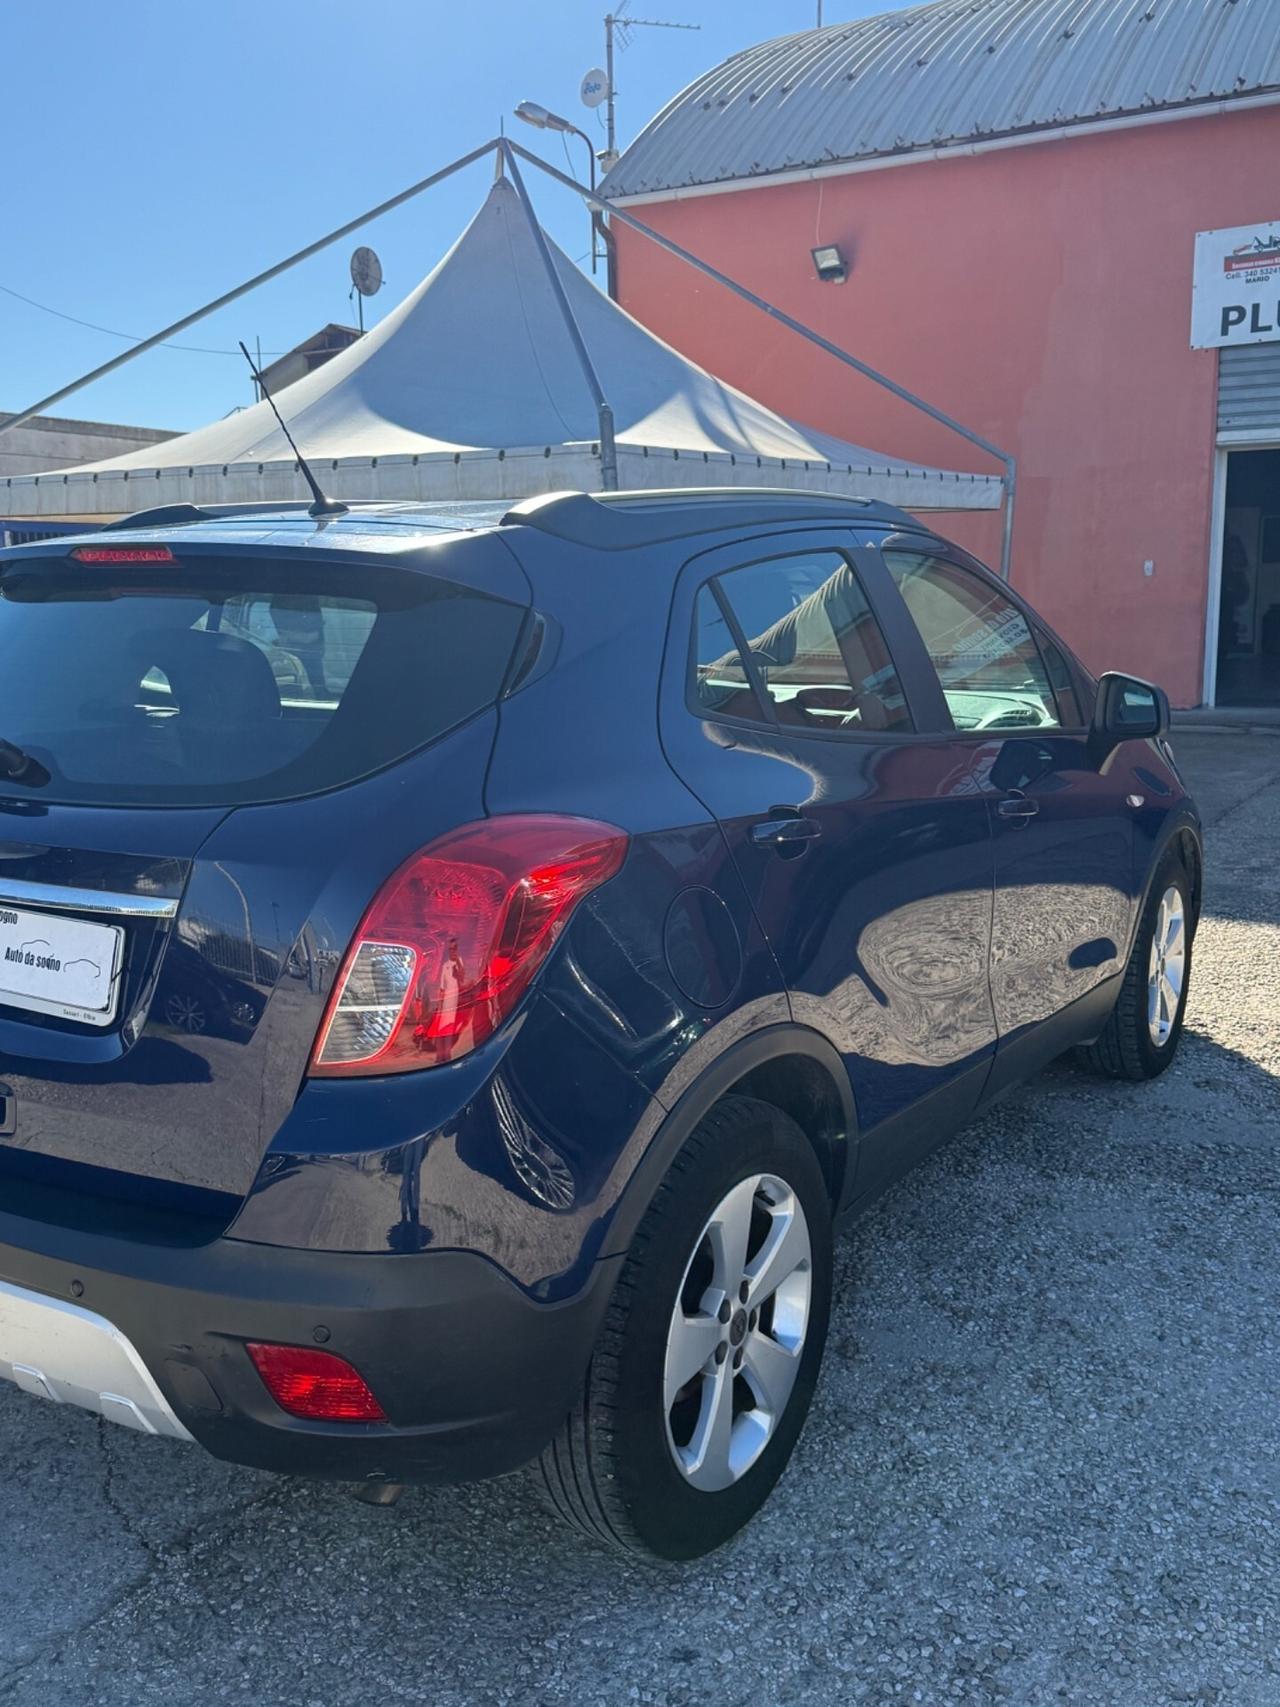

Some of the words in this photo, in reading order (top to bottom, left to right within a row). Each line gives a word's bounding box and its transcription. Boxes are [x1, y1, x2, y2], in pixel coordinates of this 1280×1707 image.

[1220, 299, 1280, 337] PL
[5, 947, 23, 963] Auto
[24, 951, 35, 966] da
[36, 956, 61, 972] sogno
